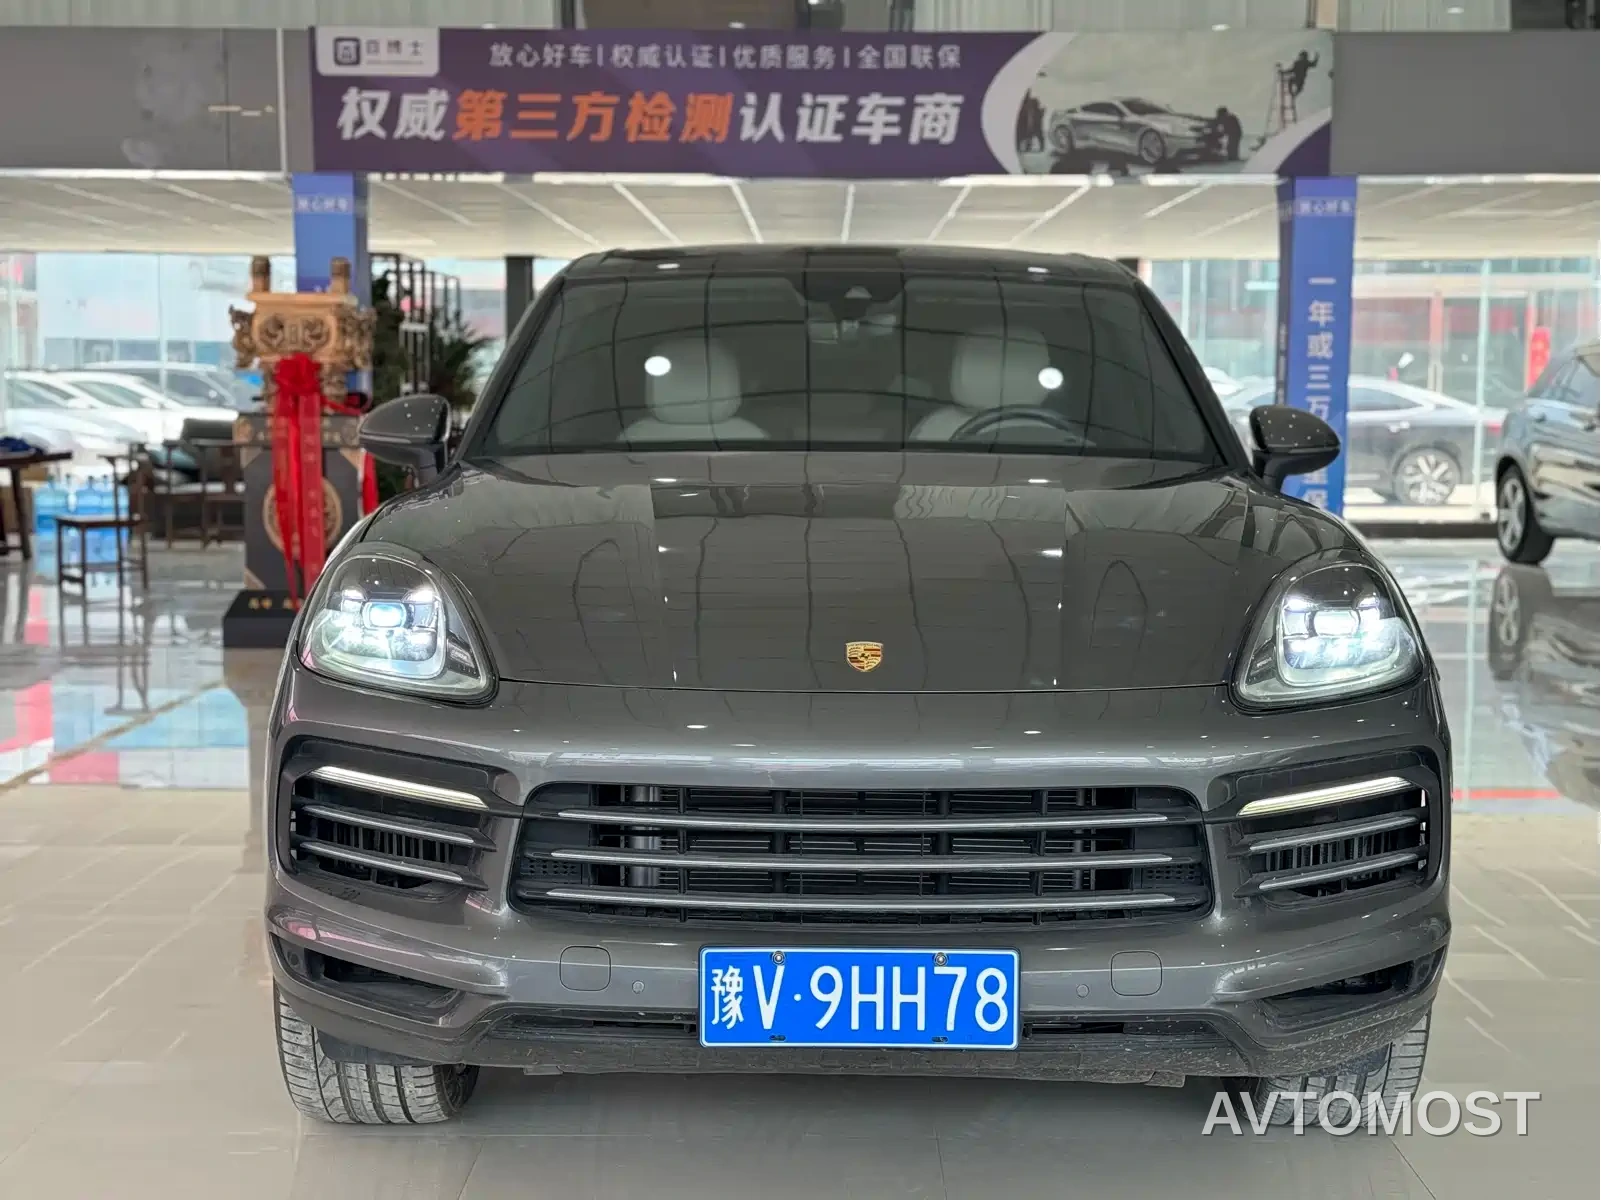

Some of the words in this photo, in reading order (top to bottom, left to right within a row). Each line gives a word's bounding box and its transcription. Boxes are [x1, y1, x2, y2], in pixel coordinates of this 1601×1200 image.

[336, 86, 965, 145] 权威第三方检测认证车商
